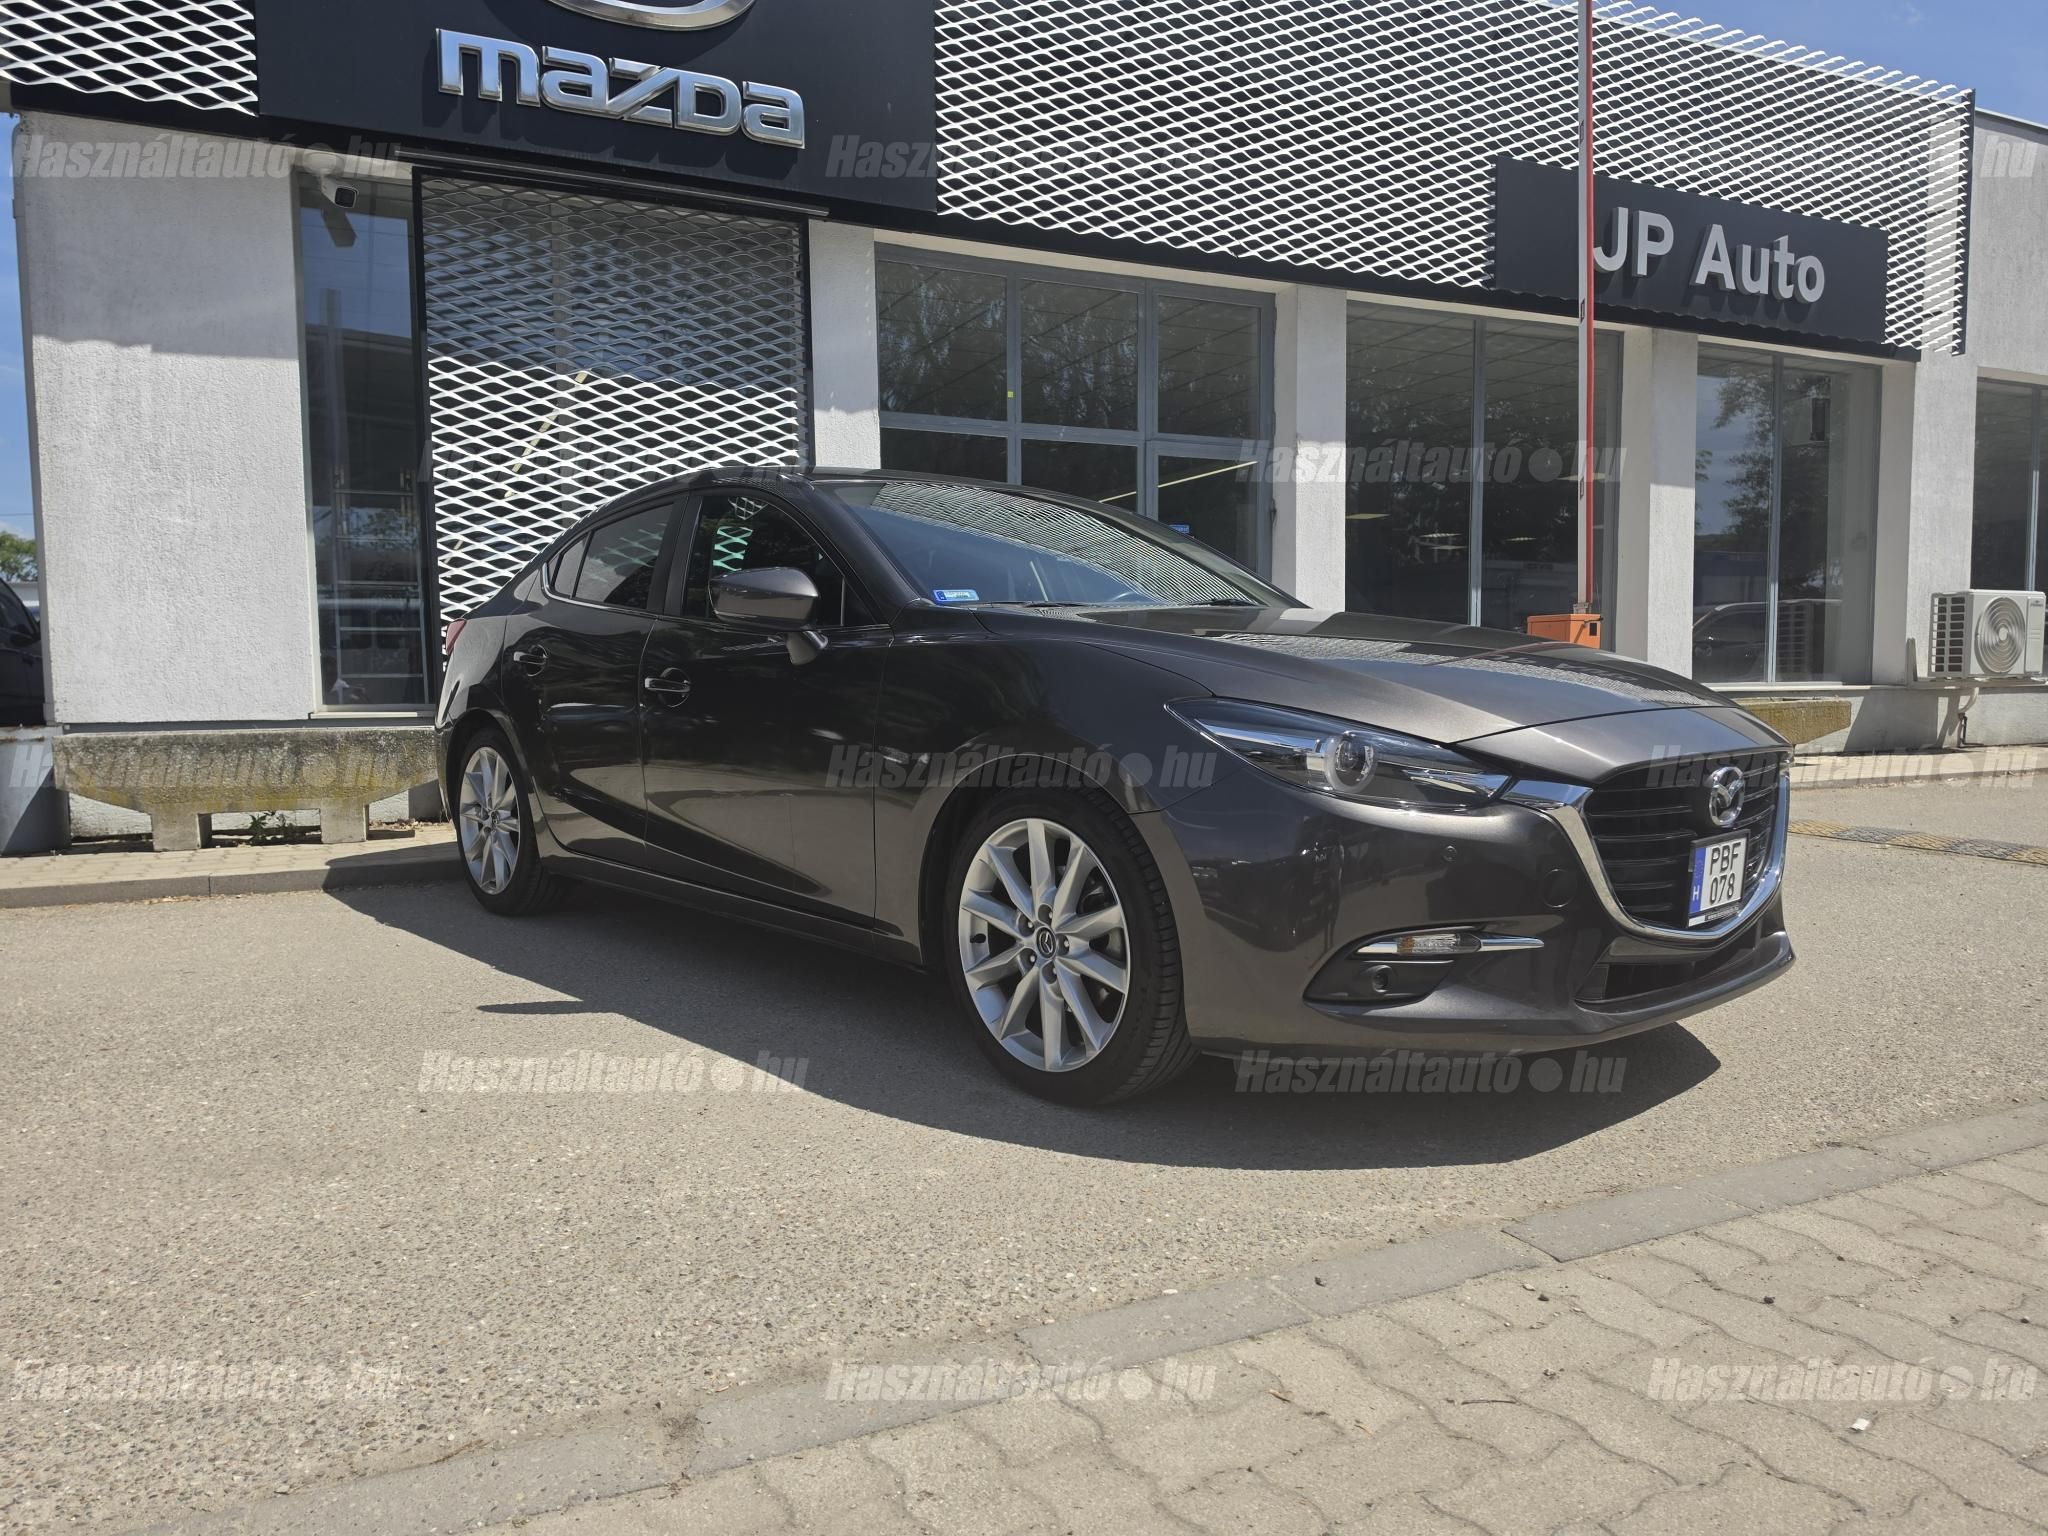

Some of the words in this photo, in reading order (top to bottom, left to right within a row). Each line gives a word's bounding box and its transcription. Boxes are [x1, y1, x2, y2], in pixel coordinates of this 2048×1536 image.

[1593, 207, 1674, 277] JP
[1690, 223, 1825, 303] Auto
[1709, 841, 1742, 876] PBF
[1692, 884, 1701, 902] H
[1709, 873, 1736, 905] 078
